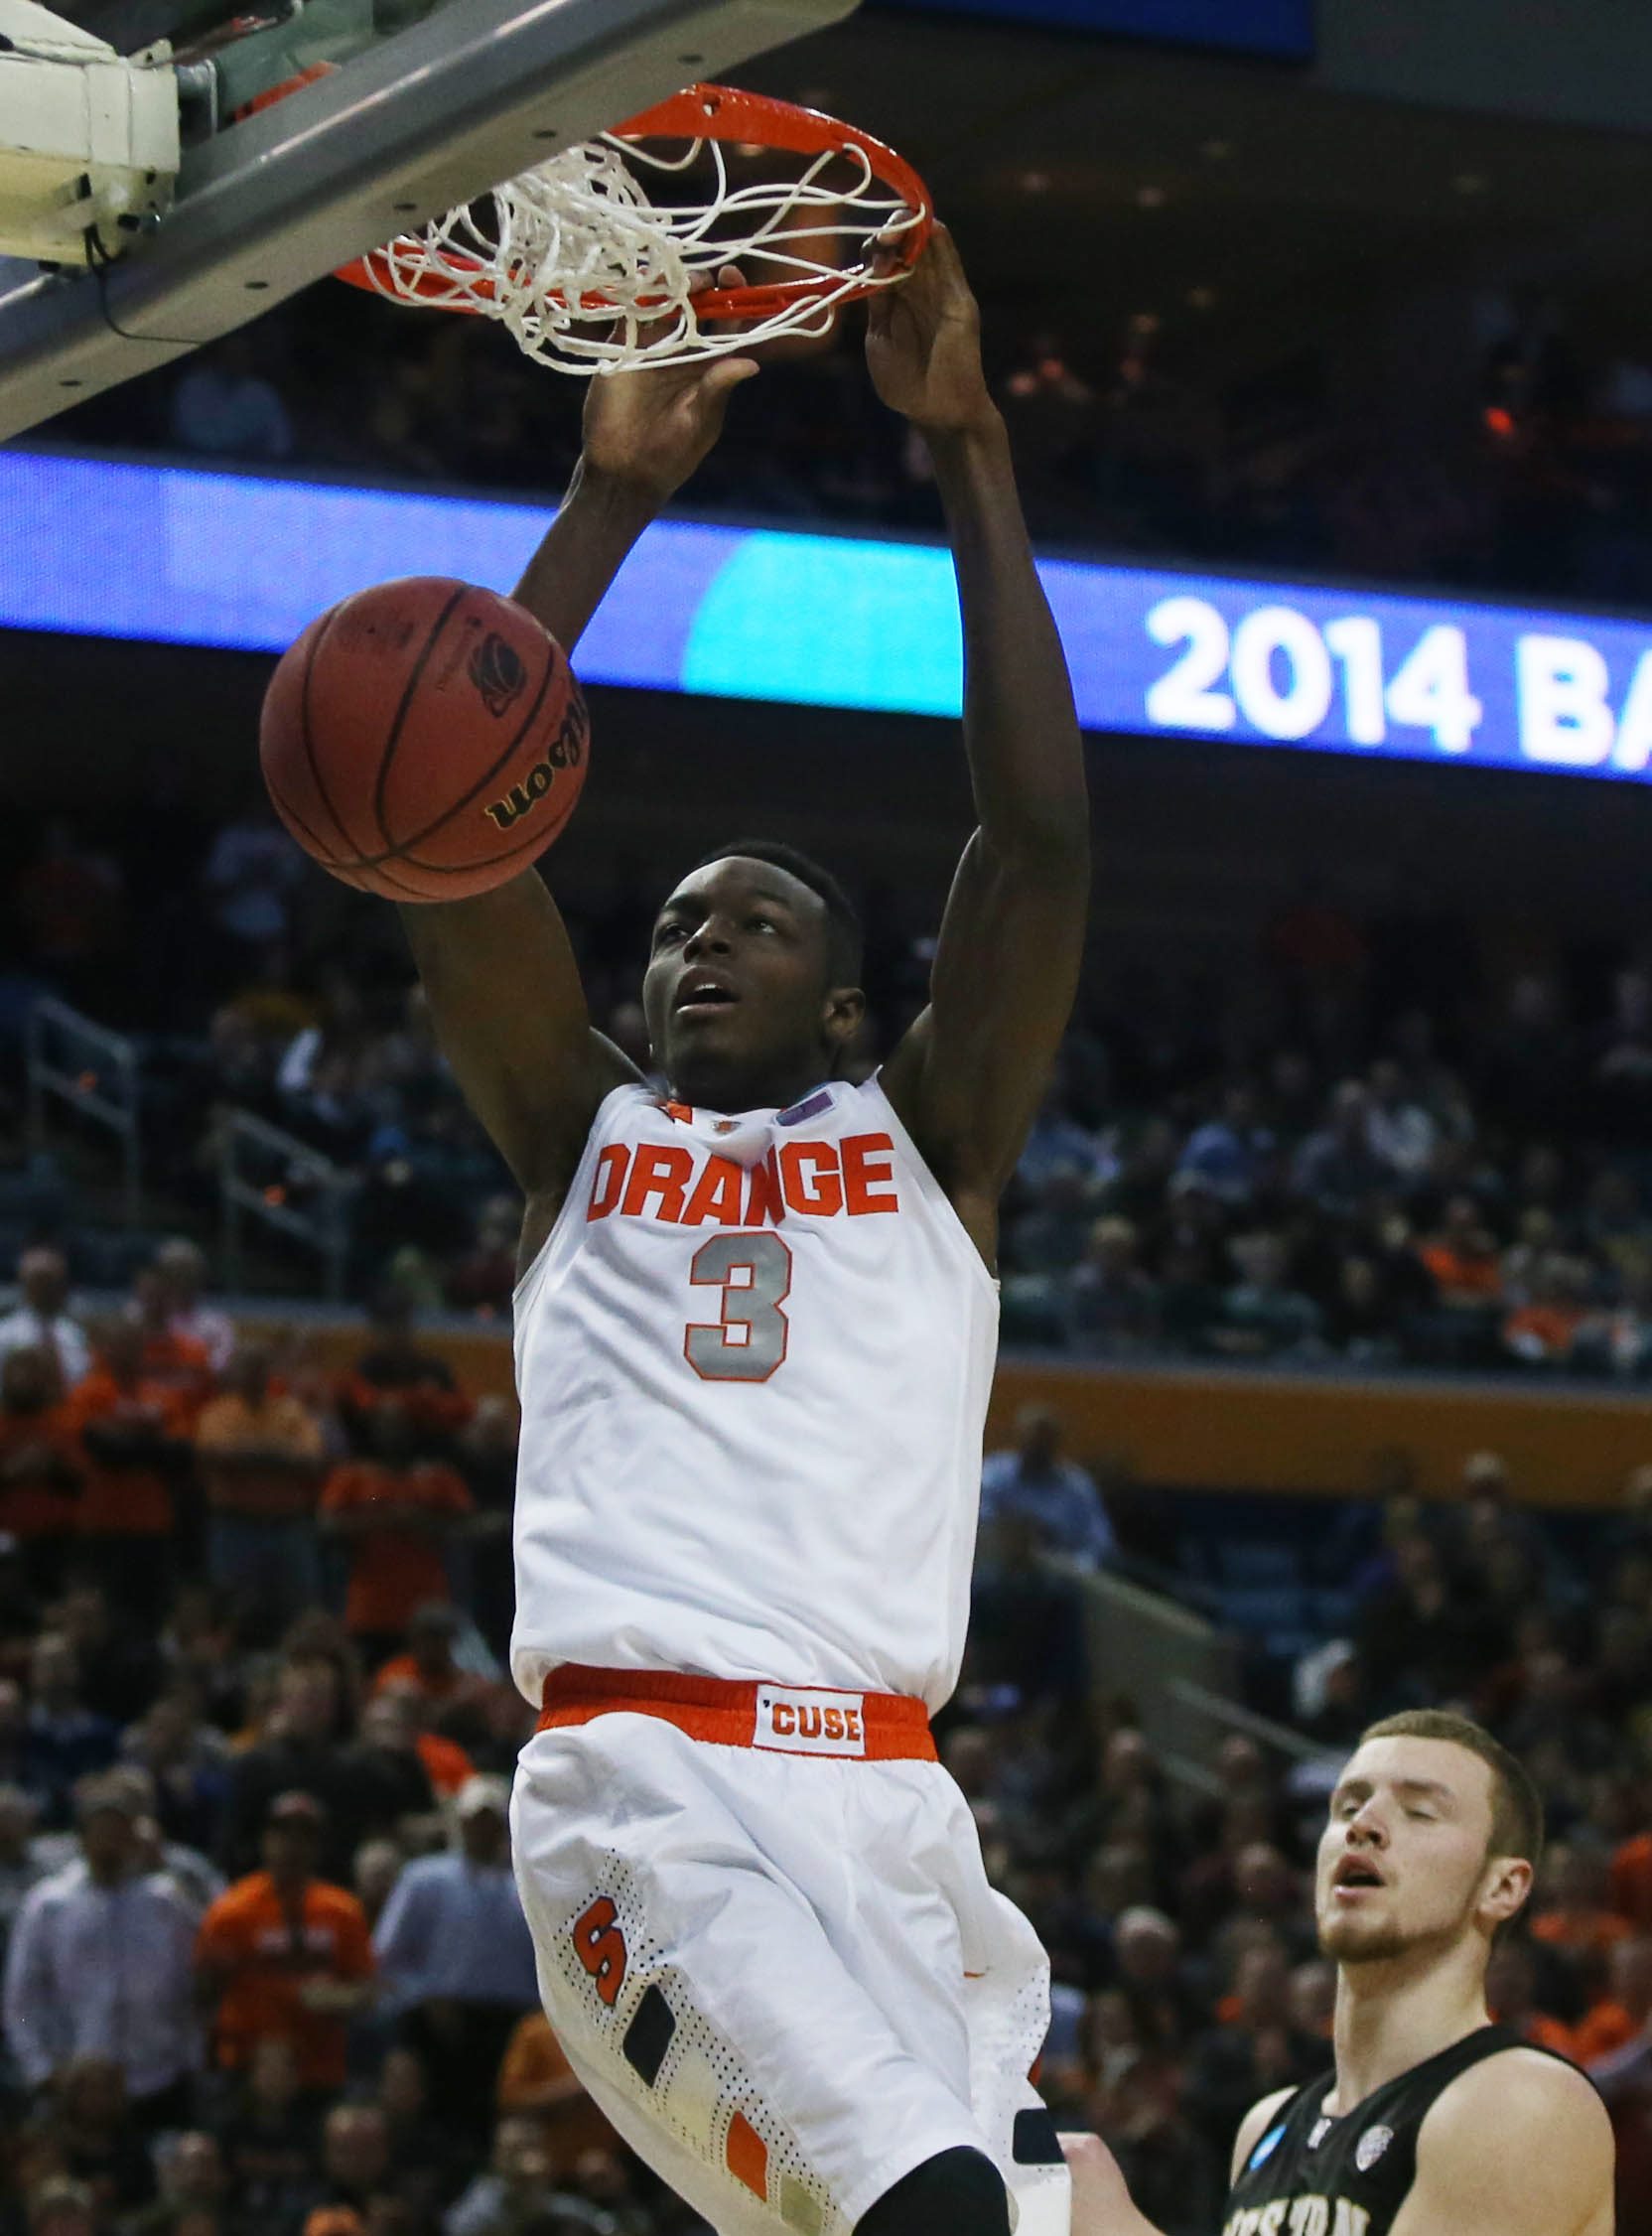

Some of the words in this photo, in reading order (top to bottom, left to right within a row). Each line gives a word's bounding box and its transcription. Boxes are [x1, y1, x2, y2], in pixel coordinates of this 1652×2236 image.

[1145, 598, 1483, 754] 2014
[587, 1132, 898, 1226] ORANGE
[684, 1230, 792, 1382] 3
